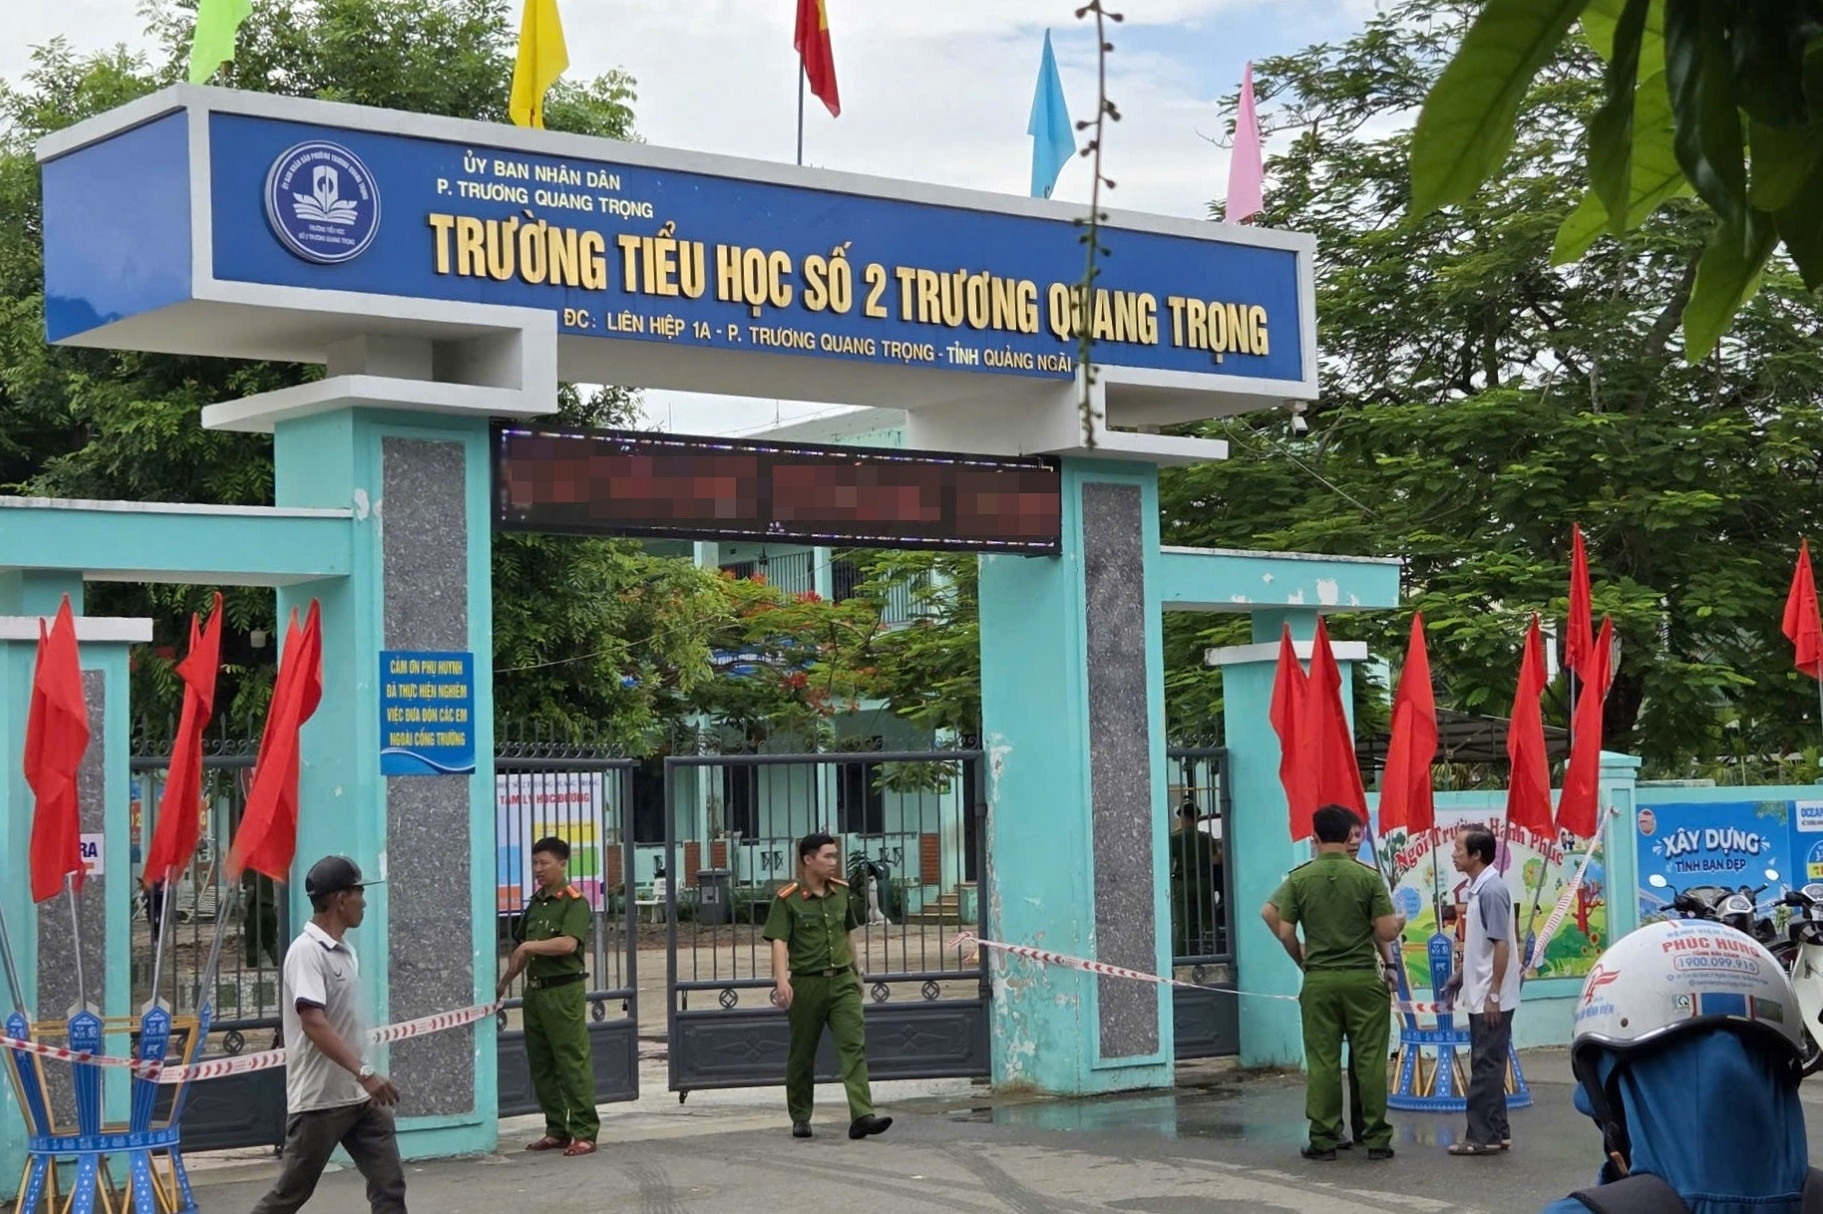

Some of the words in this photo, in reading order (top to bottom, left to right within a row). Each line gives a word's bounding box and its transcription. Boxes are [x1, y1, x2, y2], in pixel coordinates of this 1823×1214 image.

[464, 150, 487, 174] ỦY
[494, 160, 529, 180] BAN
[535, 165, 581, 186] NHÂN
[586, 169, 621, 191] DÂN
[437, 178, 453, 196] P.
[457, 180, 529, 204] TRƯƠNG
[534, 190, 594, 212] QUANG
[598, 197, 654, 221] TRỌNG
[429, 209, 607, 291] TRƯỜNG
[617, 220, 706, 299] TIỂU
[716, 244, 793, 318] HỌC
[803, 241, 853, 314] SỐ
[864, 263, 888, 318] 2
[895, 266, 1039, 335] TRƯƠNG
[1048, 281, 1159, 345] QUANG
[1167, 295, 1270, 364] TRỌNG
[607, 310, 644, 334] LIÊN
[650, 314, 686, 340] HIỆP
[692, 321, 711, 340] 1A
[728, 324, 742, 342] P.
[749, 326, 816, 350] TRƯƠNG
[820, 332, 876, 357] QUANG
[881, 340, 935, 364] TRỌNG
[946, 341, 979, 366] TỈNH
[984, 344, 1033, 370] QUẢNG
[1037, 353, 1072, 373] NGÃI
[421, 660, 437, 678] PHỤ
[455, 708, 468, 723] EM
[1662, 827, 1700, 857] XÂY
[1705, 826, 1760, 856] DỰNG
[1662, 935, 1710, 953] PHÚC
